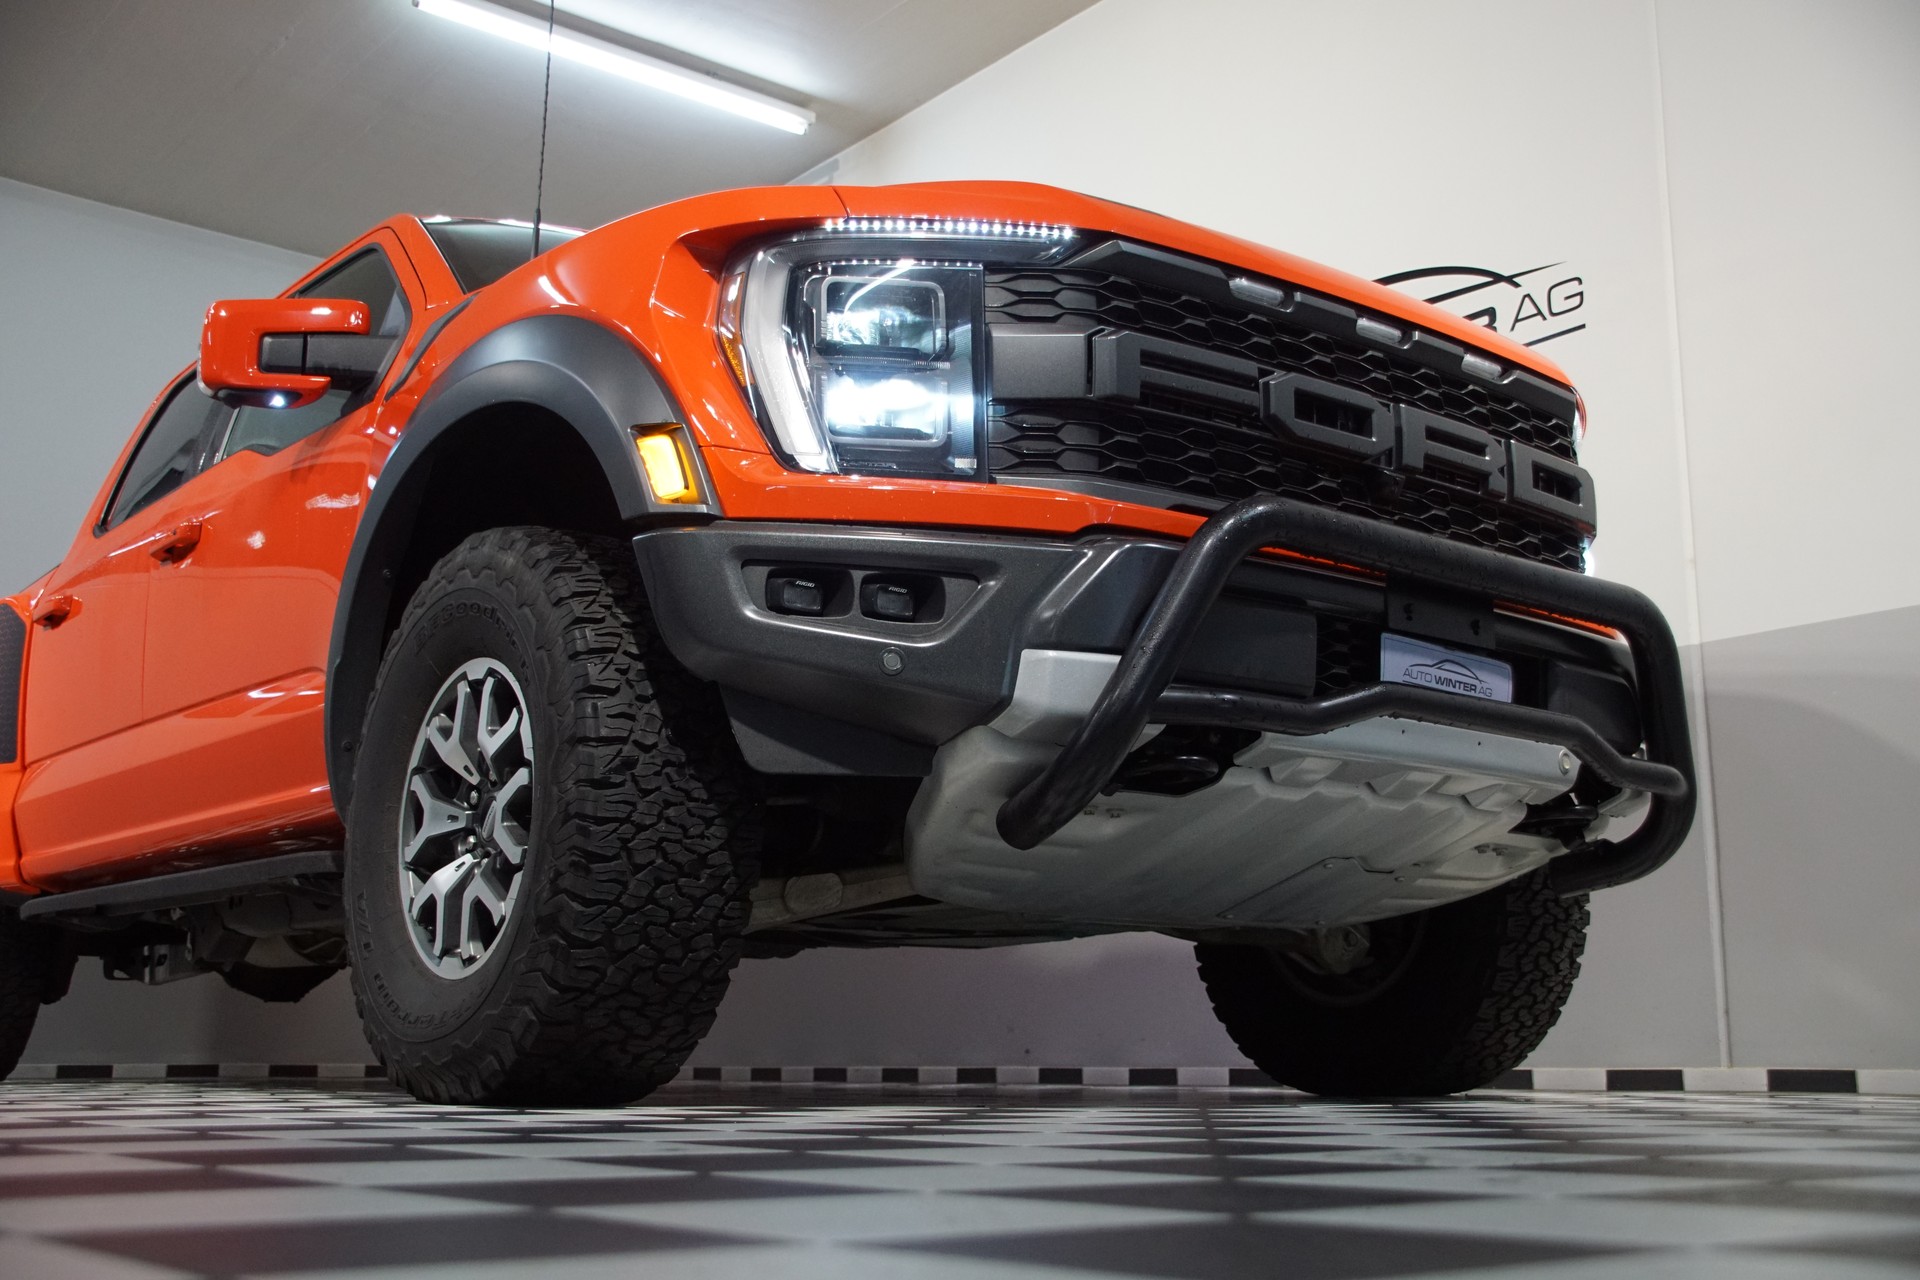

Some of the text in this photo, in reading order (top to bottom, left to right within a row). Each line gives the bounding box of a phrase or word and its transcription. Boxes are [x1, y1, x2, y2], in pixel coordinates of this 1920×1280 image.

[1509, 276, 1584, 333] AG
[1095, 327, 1597, 543] FORD
[795, 580, 816, 588] RIGID
[1402, 667, 1493, 698] AUTO WINTER AG
